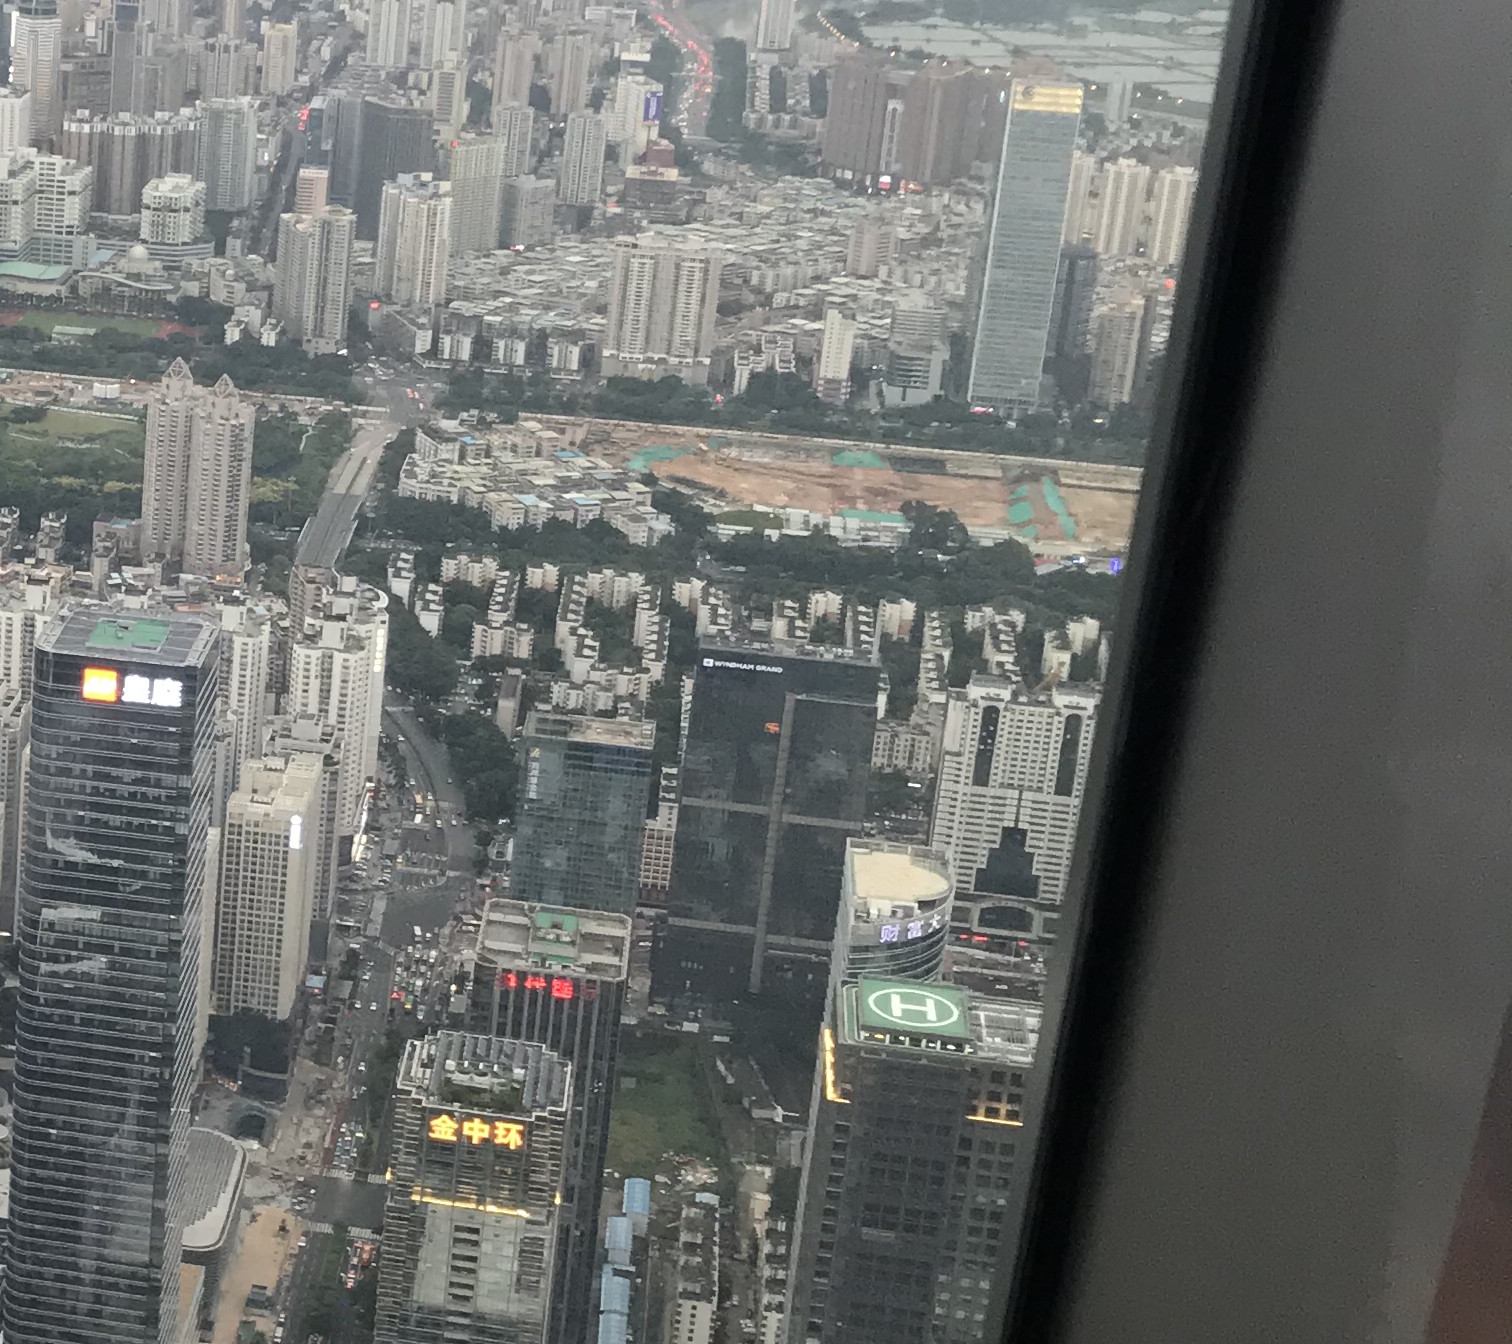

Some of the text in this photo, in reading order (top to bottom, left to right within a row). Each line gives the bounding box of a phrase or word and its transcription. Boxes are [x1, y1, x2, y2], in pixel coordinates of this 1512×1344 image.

[879, 913, 949, 944] 财富大
[428, 1114, 525, 1150] 金中环
